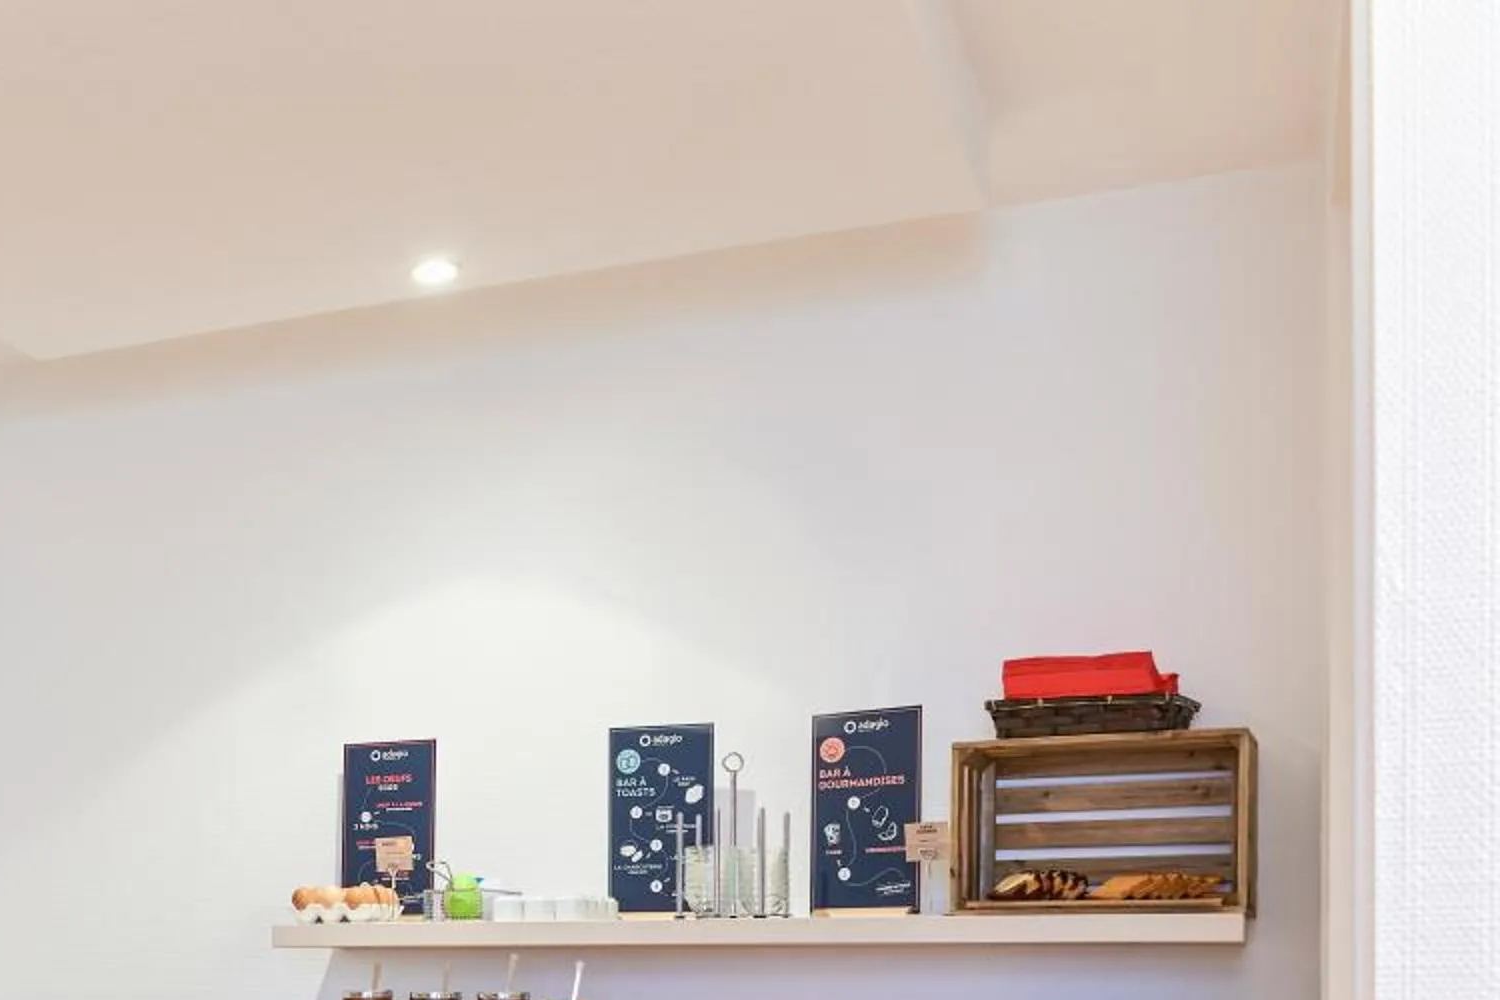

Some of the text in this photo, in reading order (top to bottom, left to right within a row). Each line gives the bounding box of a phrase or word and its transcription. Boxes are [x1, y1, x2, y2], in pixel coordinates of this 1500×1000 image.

[819, 765, 851, 779] BAR À
[616, 775, 647, 787] BAR À
[818, 775, 905, 789] GOURMANDISES
[616, 787, 656, 797] TOASTS
